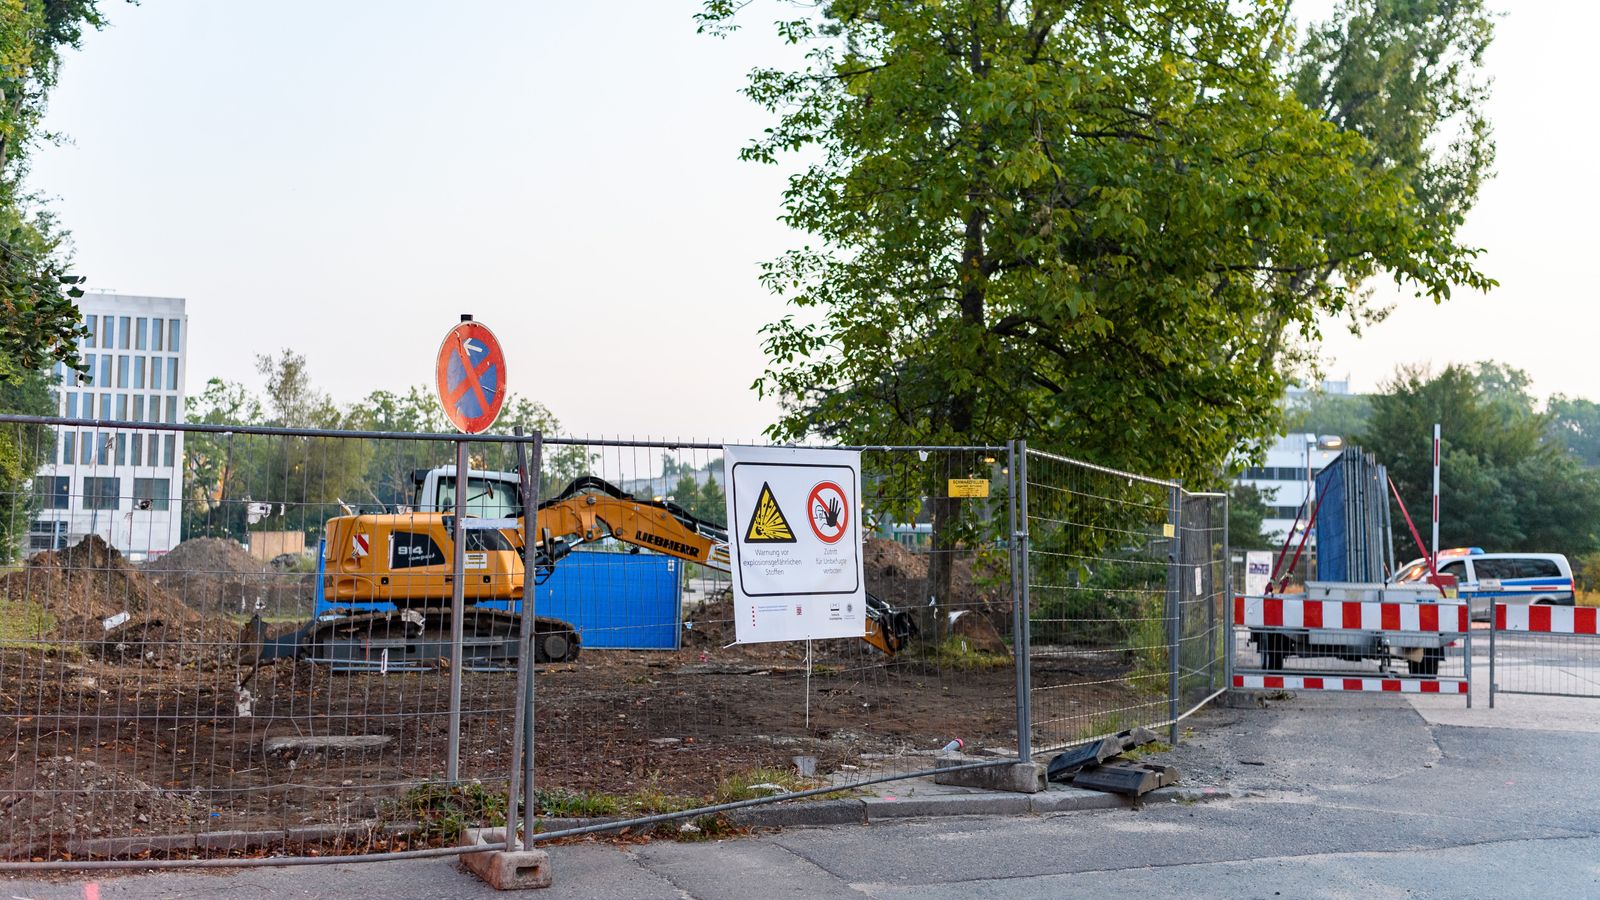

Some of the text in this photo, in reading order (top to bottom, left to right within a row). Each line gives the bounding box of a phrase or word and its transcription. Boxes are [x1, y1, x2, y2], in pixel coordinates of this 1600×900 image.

[635, 530, 700, 557] LIEBHERR
[398, 546, 423, 555] 914
[754, 549, 780, 558] Warnung
[408, 553, 435, 561] compact
[742, 558, 802, 568] explosionsgefährlichen
[765, 568, 785, 576] Stoffen
